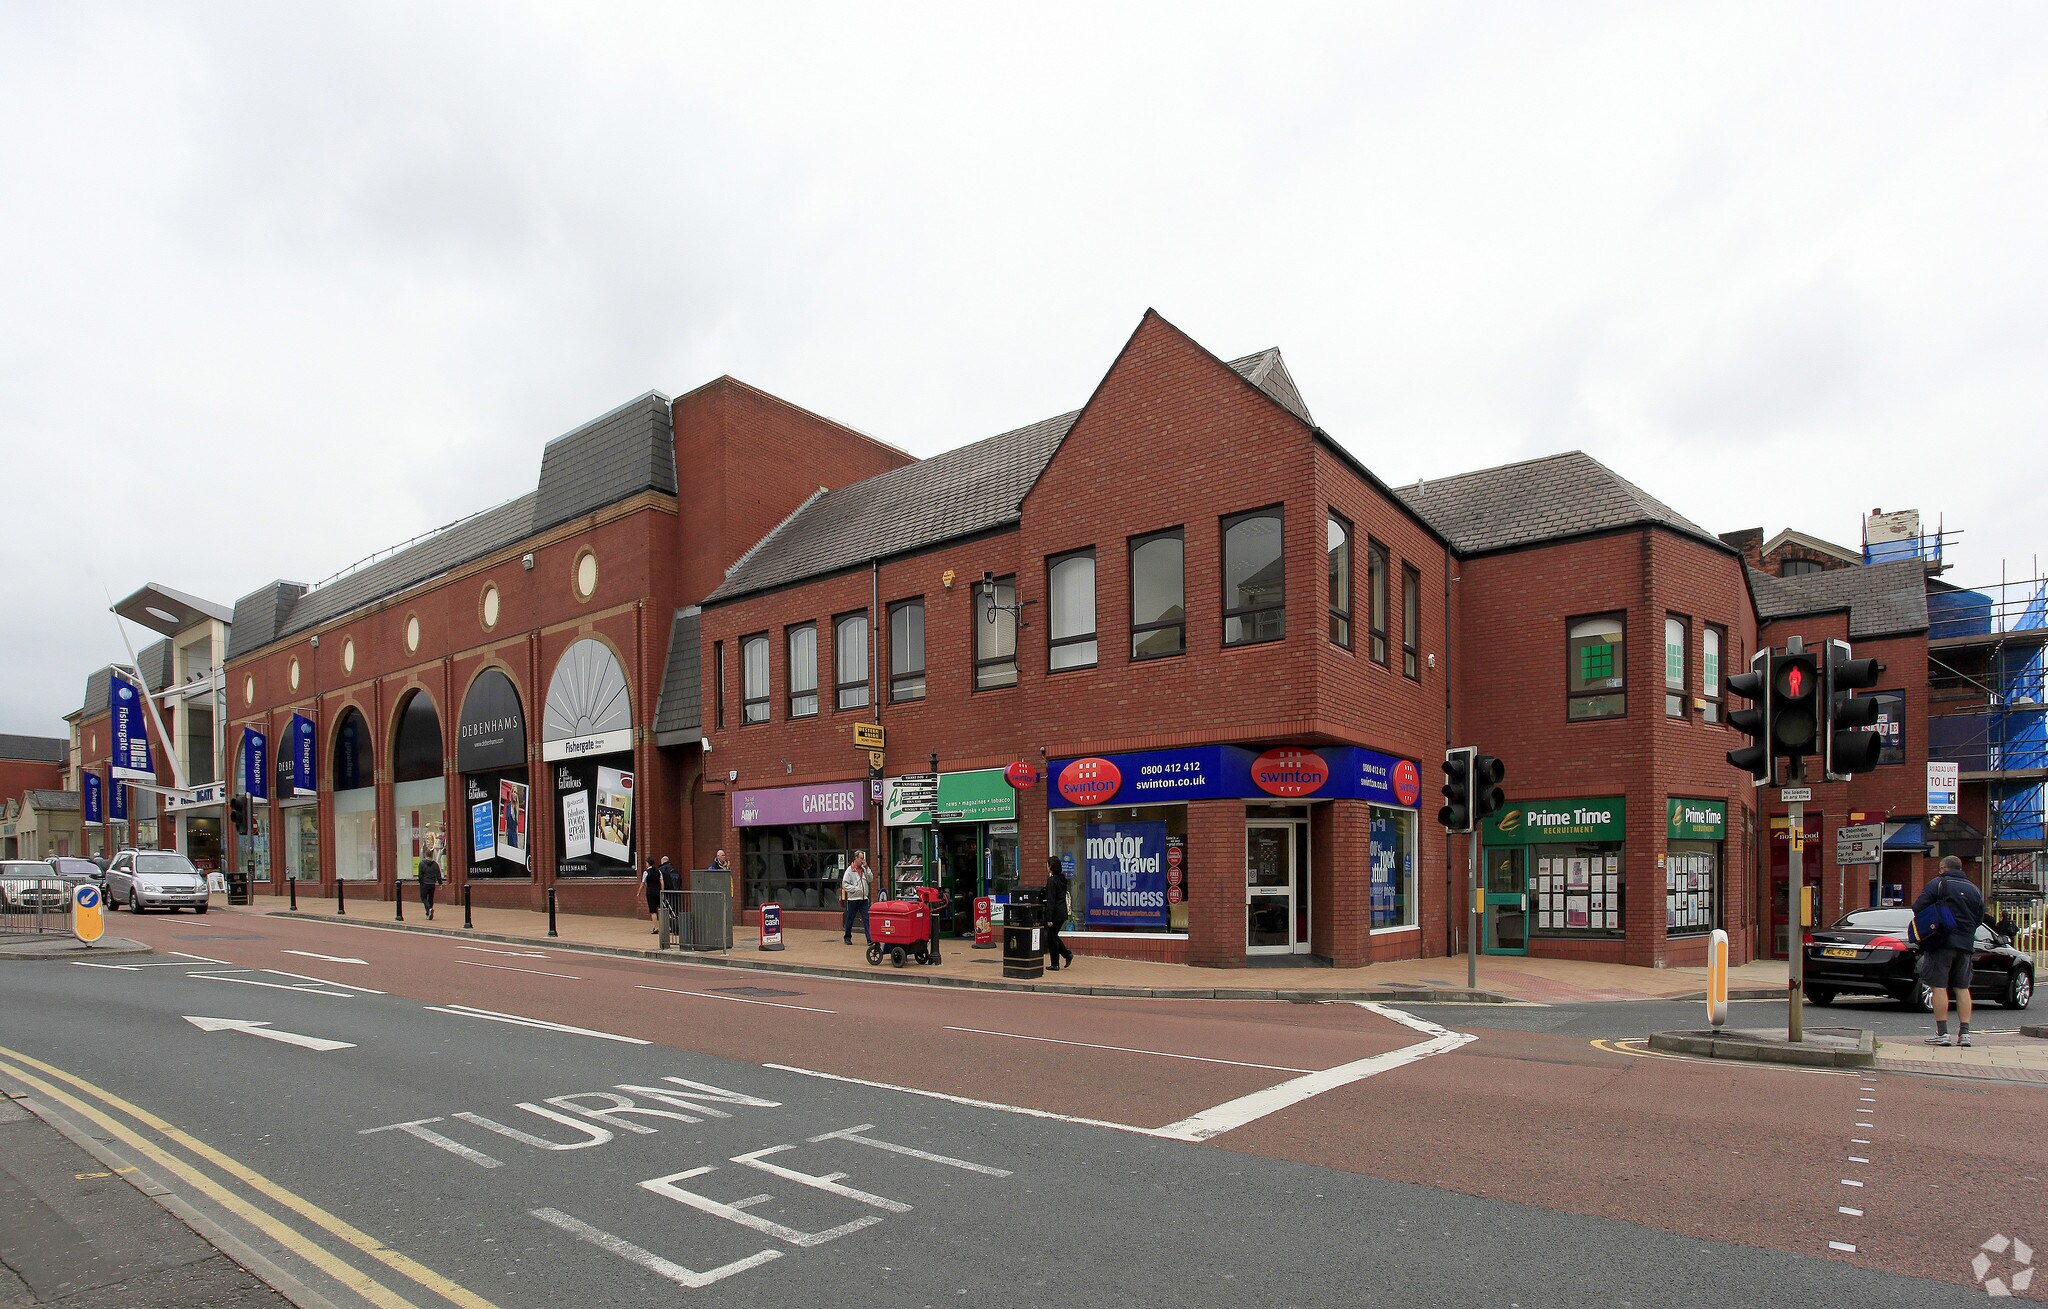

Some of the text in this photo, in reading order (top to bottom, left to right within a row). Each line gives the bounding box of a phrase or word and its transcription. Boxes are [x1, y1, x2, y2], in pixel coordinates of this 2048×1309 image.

[118, 707, 129, 751] Fishergate
[462, 715, 518, 738] DEBENHAMS
[566, 740, 594, 754] Fishergate
[302, 738, 310, 775] Fishergate
[254, 750, 262, 784] Fishergate
[1141, 761, 1200, 775] 0800 412 412
[1362, 763, 1371, 773] 0800
[1136, 774, 1206, 790] swinton.co.uk
[1260, 770, 1322, 784] swinton
[1360, 776, 1388, 790] swinton.co.uk
[1930, 777, 1957, 787] TO LET
[1063, 779, 1115, 794] swinton
[802, 792, 855, 813] CAREERS
[741, 809, 759, 821] ARMY
[1527, 807, 1611, 827] Prime Time
[1685, 806, 1721, 824] Prime Time
[1543, 825, 1594, 835] RECRUITMENT
[1086, 832, 1143, 859] motor
[560, 864, 587, 872] DEBENHAMS
[1119, 853, 1160, 873] travel
[1091, 866, 1136, 889] home
[1103, 886, 1164, 907] business
[765, 917, 780, 926] cash
[358, 1076, 782, 1168] TURN
[527, 1124, 1013, 1288] LEFT
